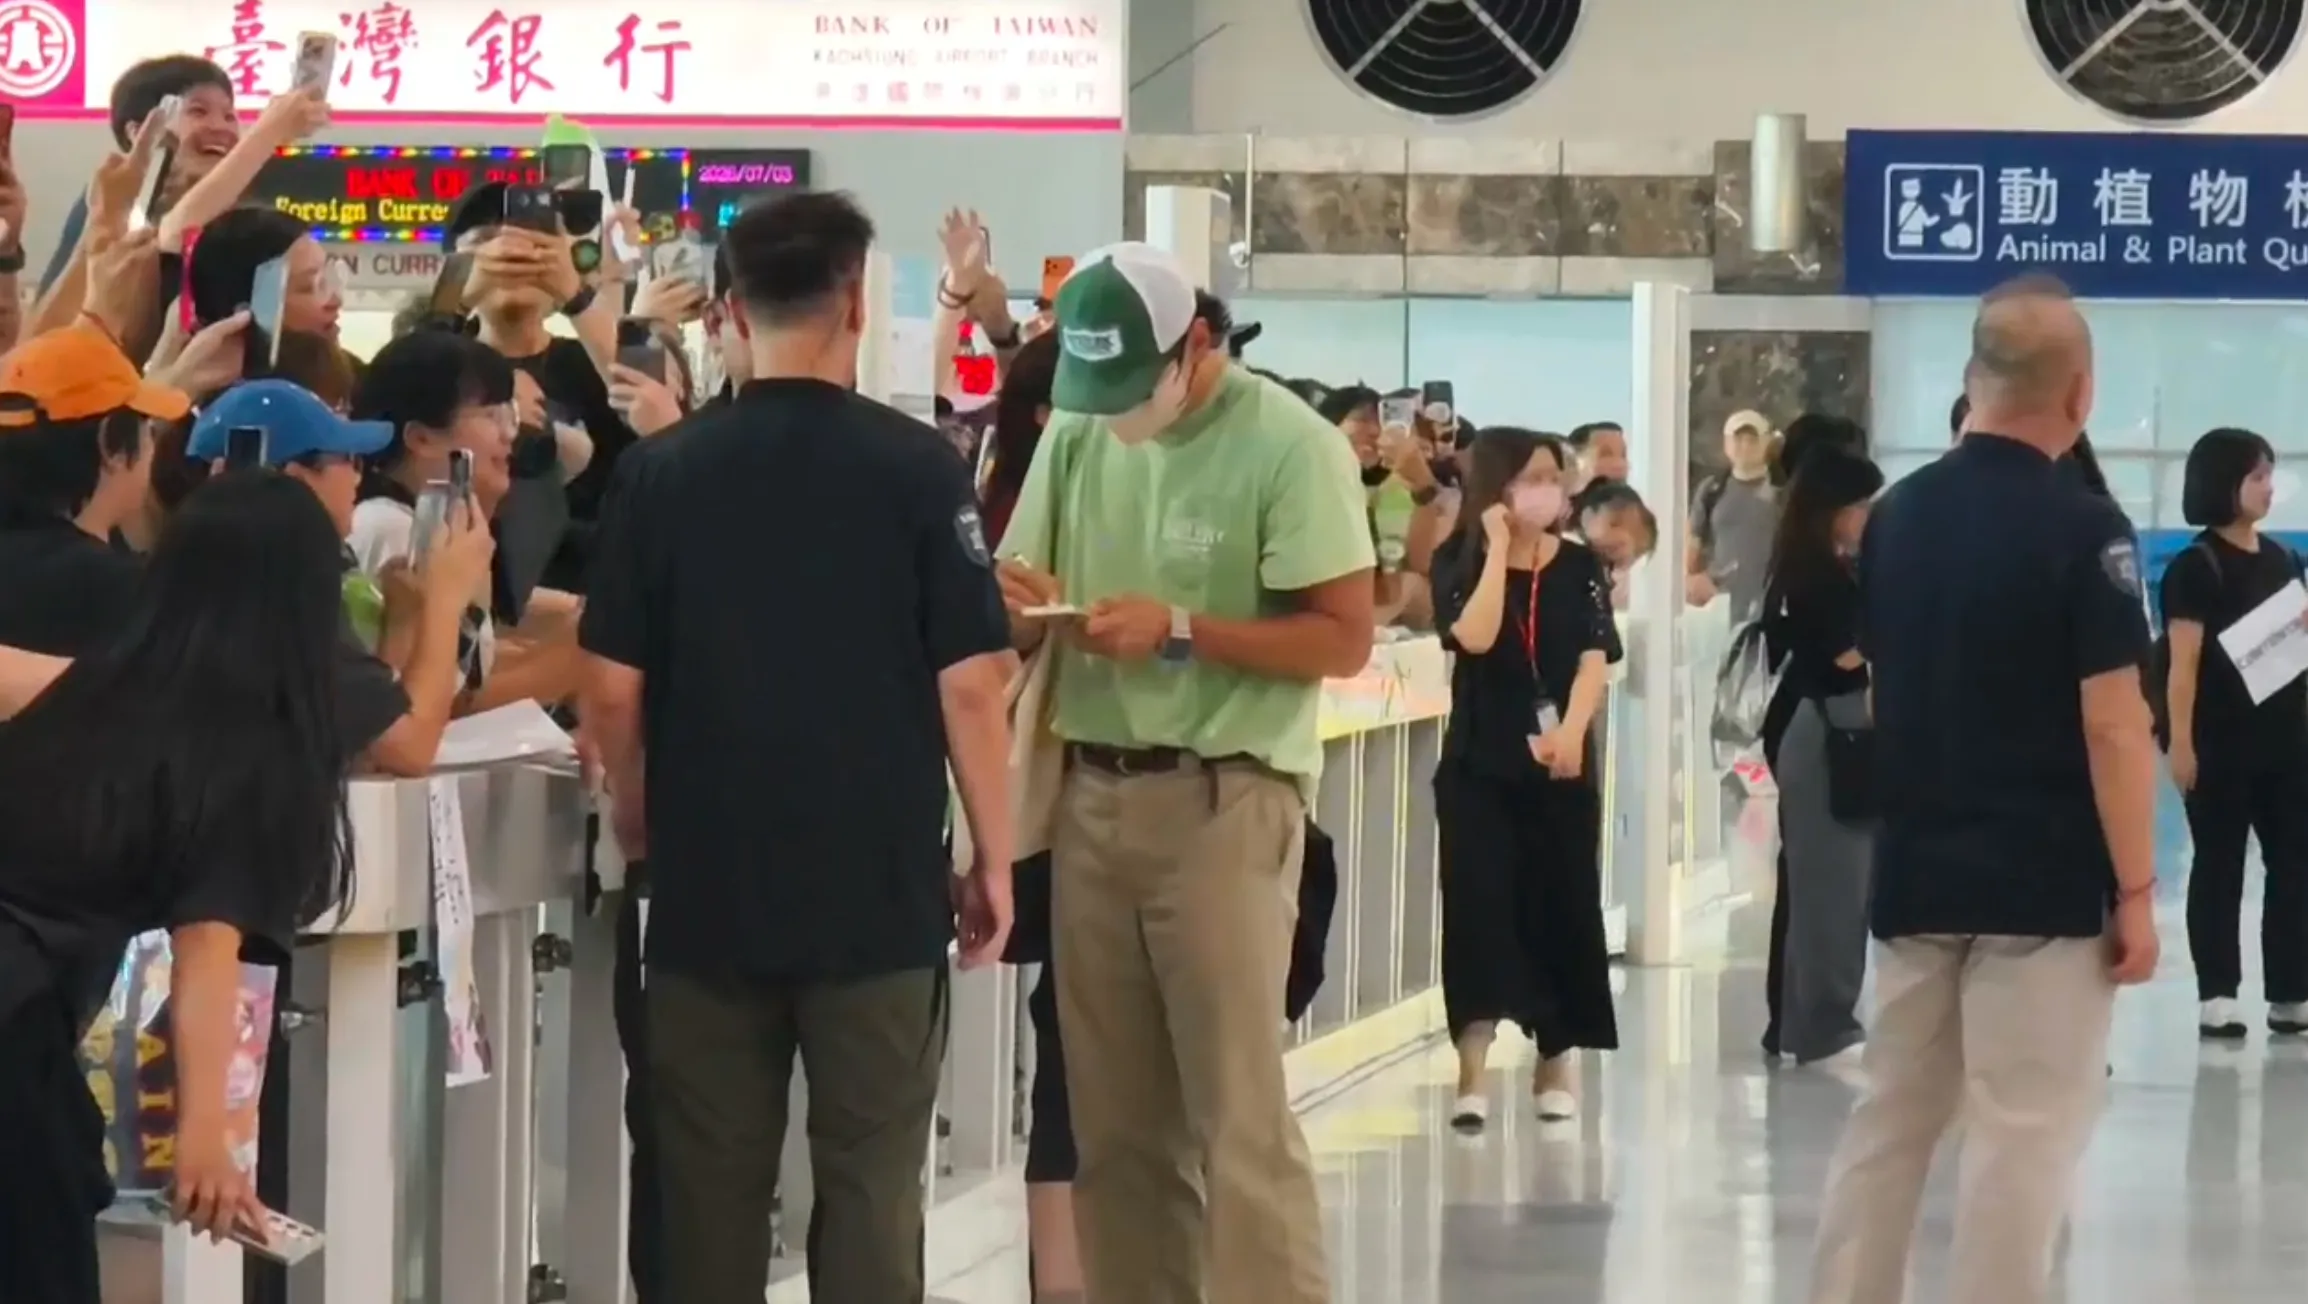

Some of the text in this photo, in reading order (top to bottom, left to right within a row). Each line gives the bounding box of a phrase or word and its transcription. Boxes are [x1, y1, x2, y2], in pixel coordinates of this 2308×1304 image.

[814, 14, 1098, 36] BANK OF TAIWAN
[204, 0, 692, 104] 臺灣銀行
[347, 167, 418, 199] BANK
[276, 196, 449, 225] Foreign Curre
[1996, 233, 2106, 263] Animal
[2123, 235, 2152, 264] &
[2168, 235, 2247, 264] Plant
[372, 253, 440, 276] CURR
